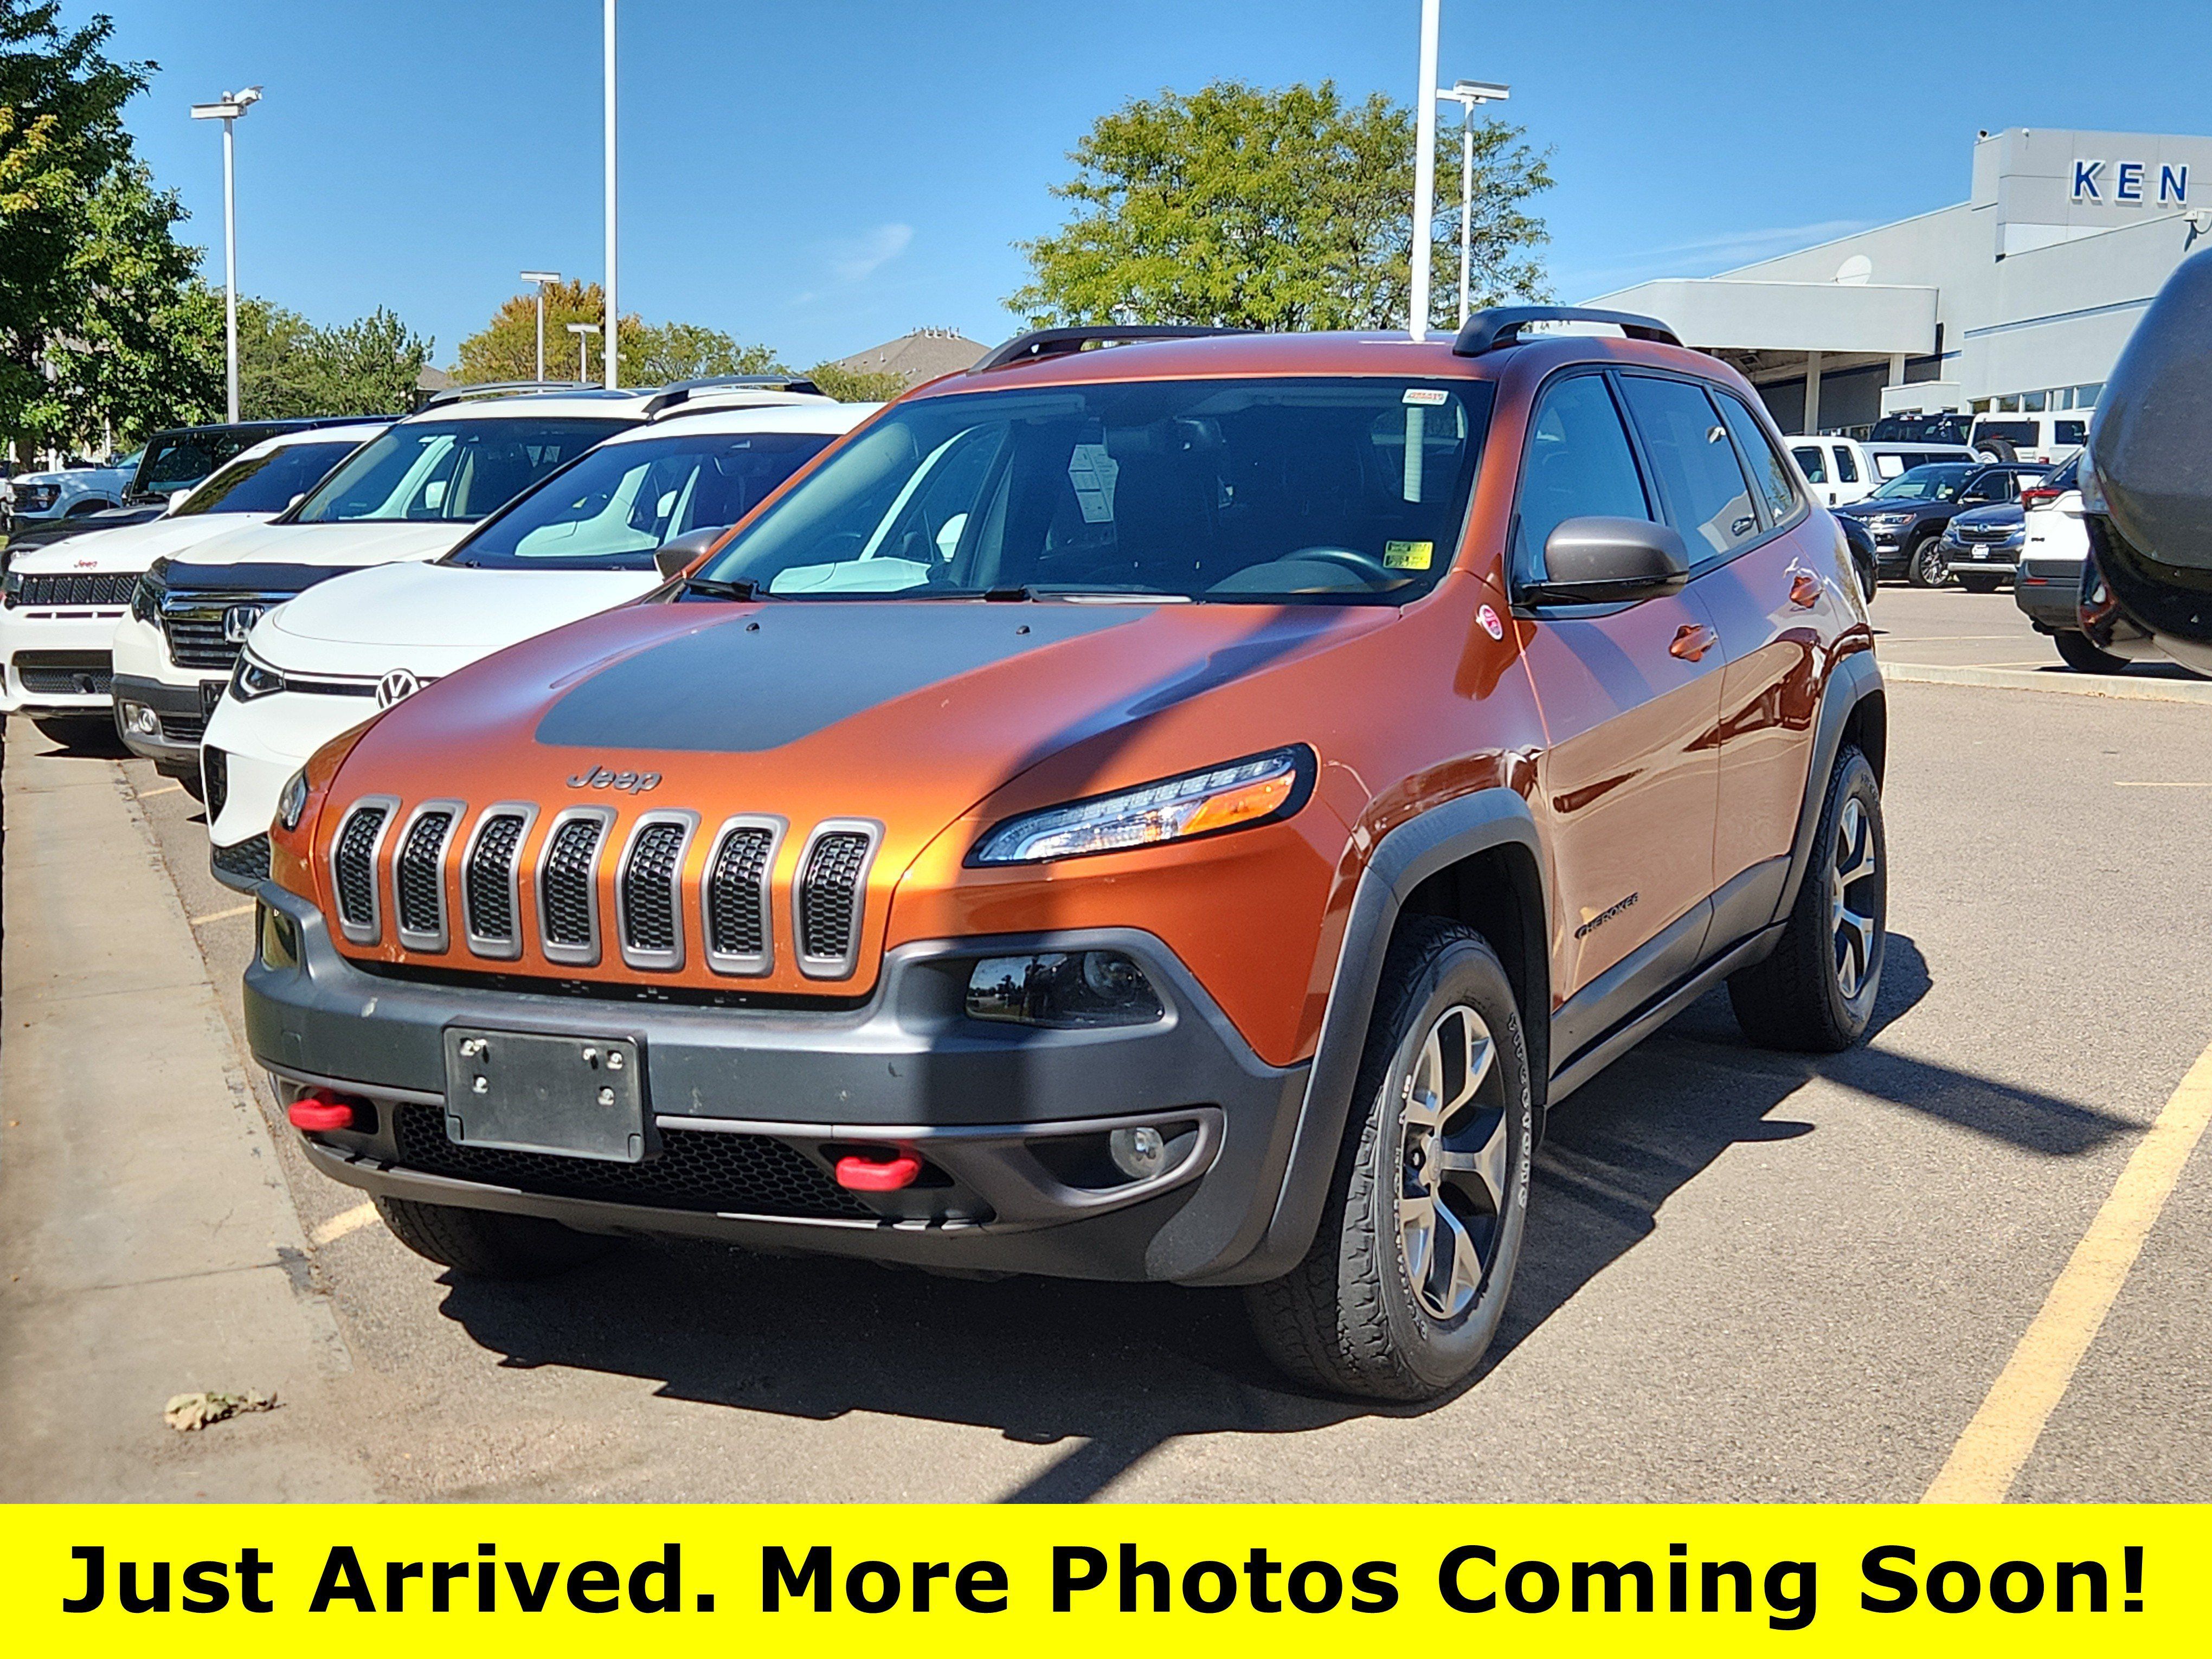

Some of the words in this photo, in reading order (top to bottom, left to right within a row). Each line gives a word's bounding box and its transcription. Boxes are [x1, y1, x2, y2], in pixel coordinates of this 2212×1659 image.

[2071, 159, 2189, 205] KEN
[566, 764, 663, 795] Jeep
[1574, 892, 1638, 940] CHEROKEE
